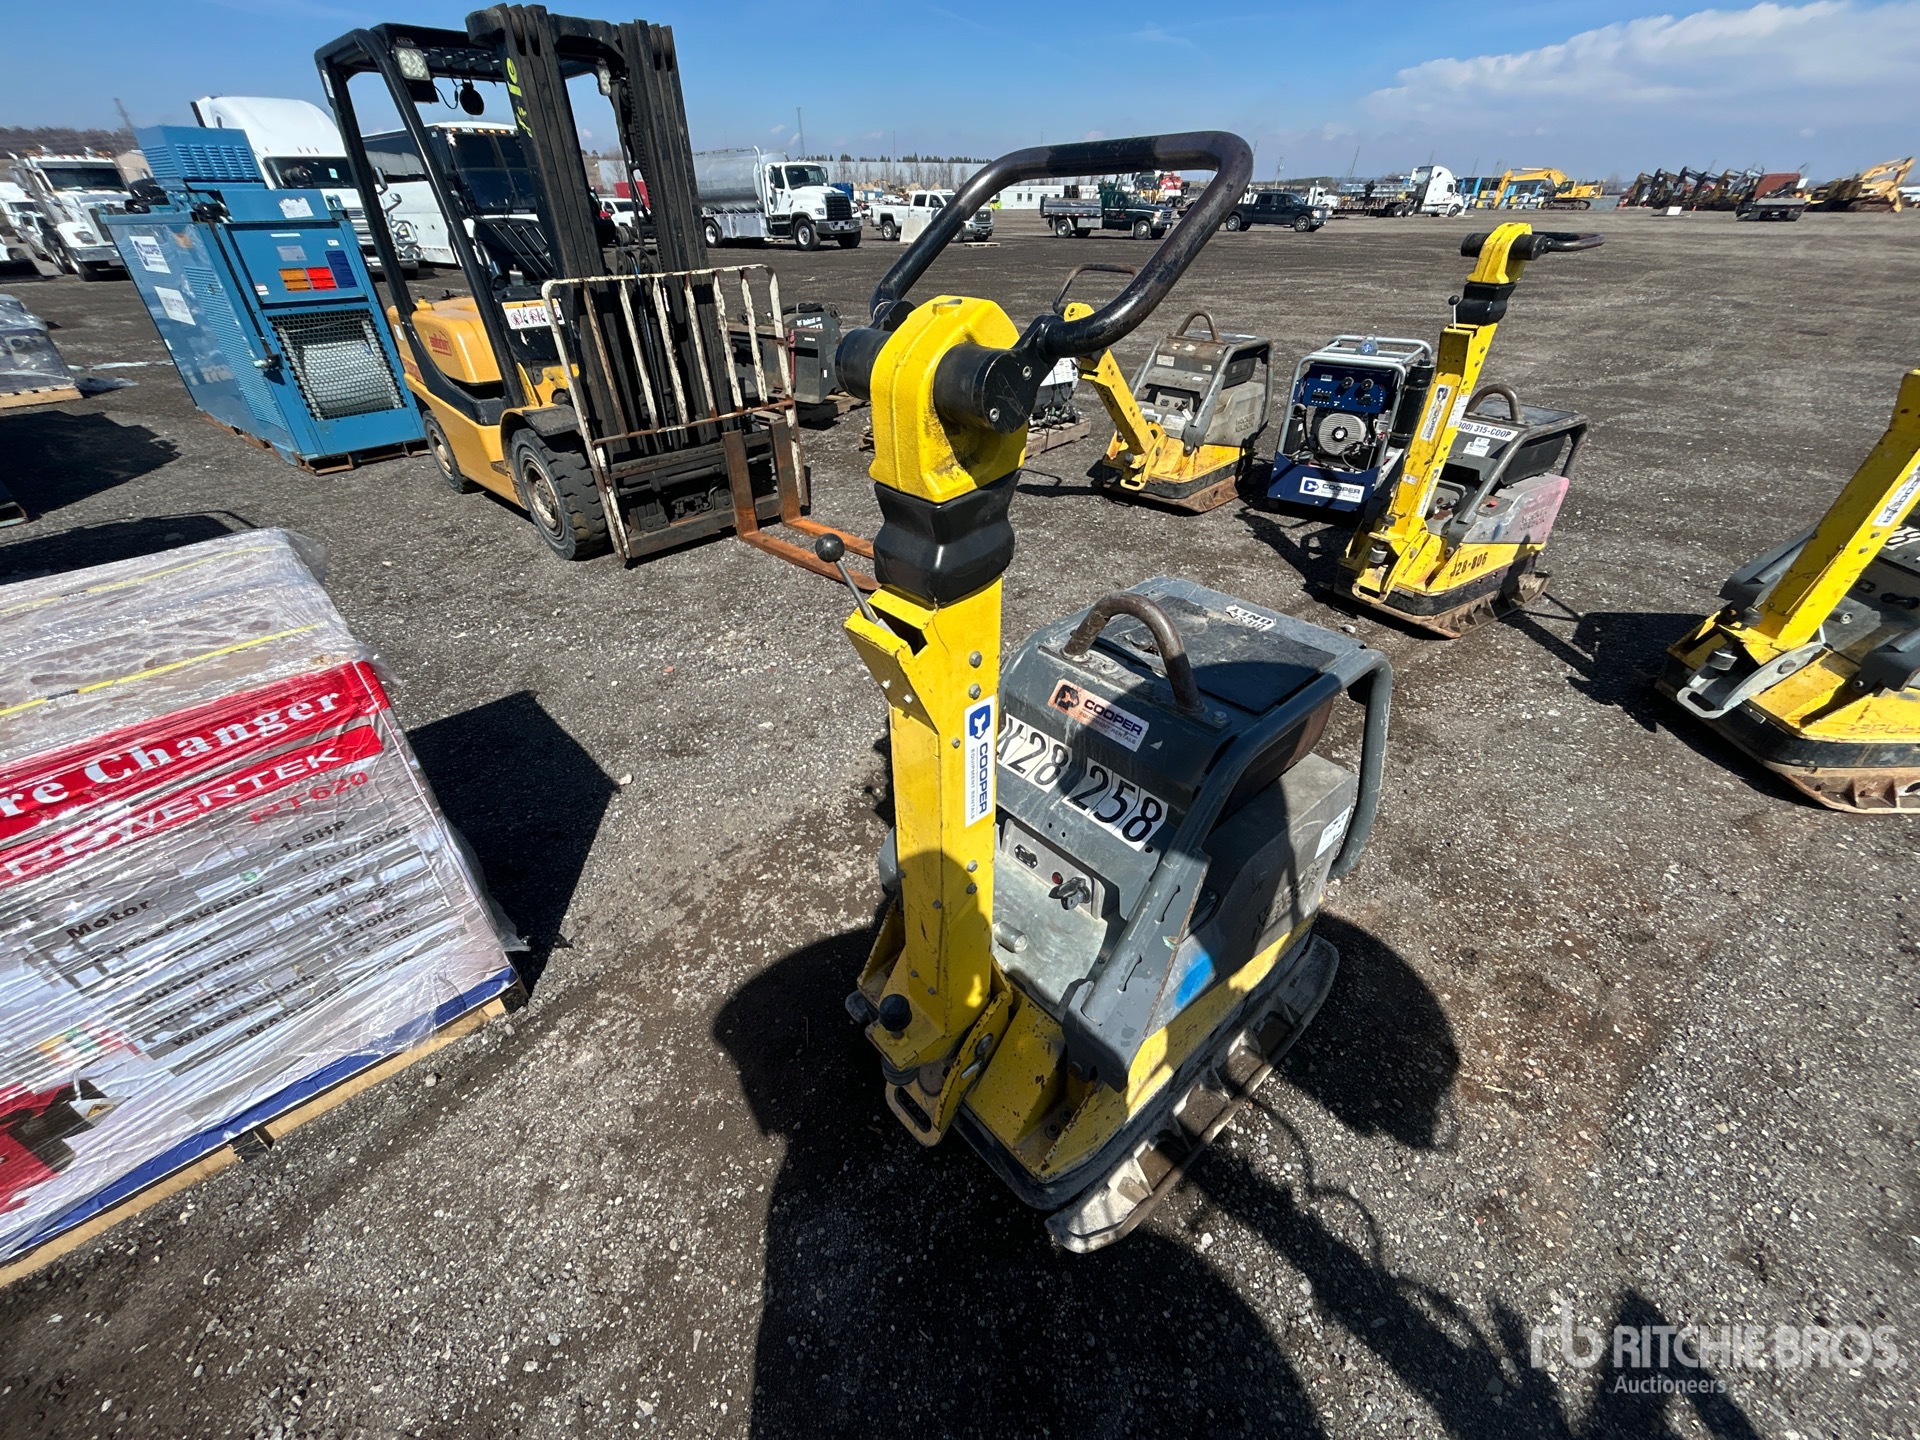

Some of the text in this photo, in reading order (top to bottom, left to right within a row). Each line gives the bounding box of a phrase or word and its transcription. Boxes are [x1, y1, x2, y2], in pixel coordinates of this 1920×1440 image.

[1322, 484, 1361, 494] COOPER
[1084, 699, 1143, 735] COOPER
[84, 693, 339, 784] Changer
[979, 742, 988, 814] COOPER
[1067, 764, 1163, 843] 258
[280, 821, 346, 851] 1.5HP
[312, 876, 354, 897] 12A
[66, 899, 150, 939] Motor
